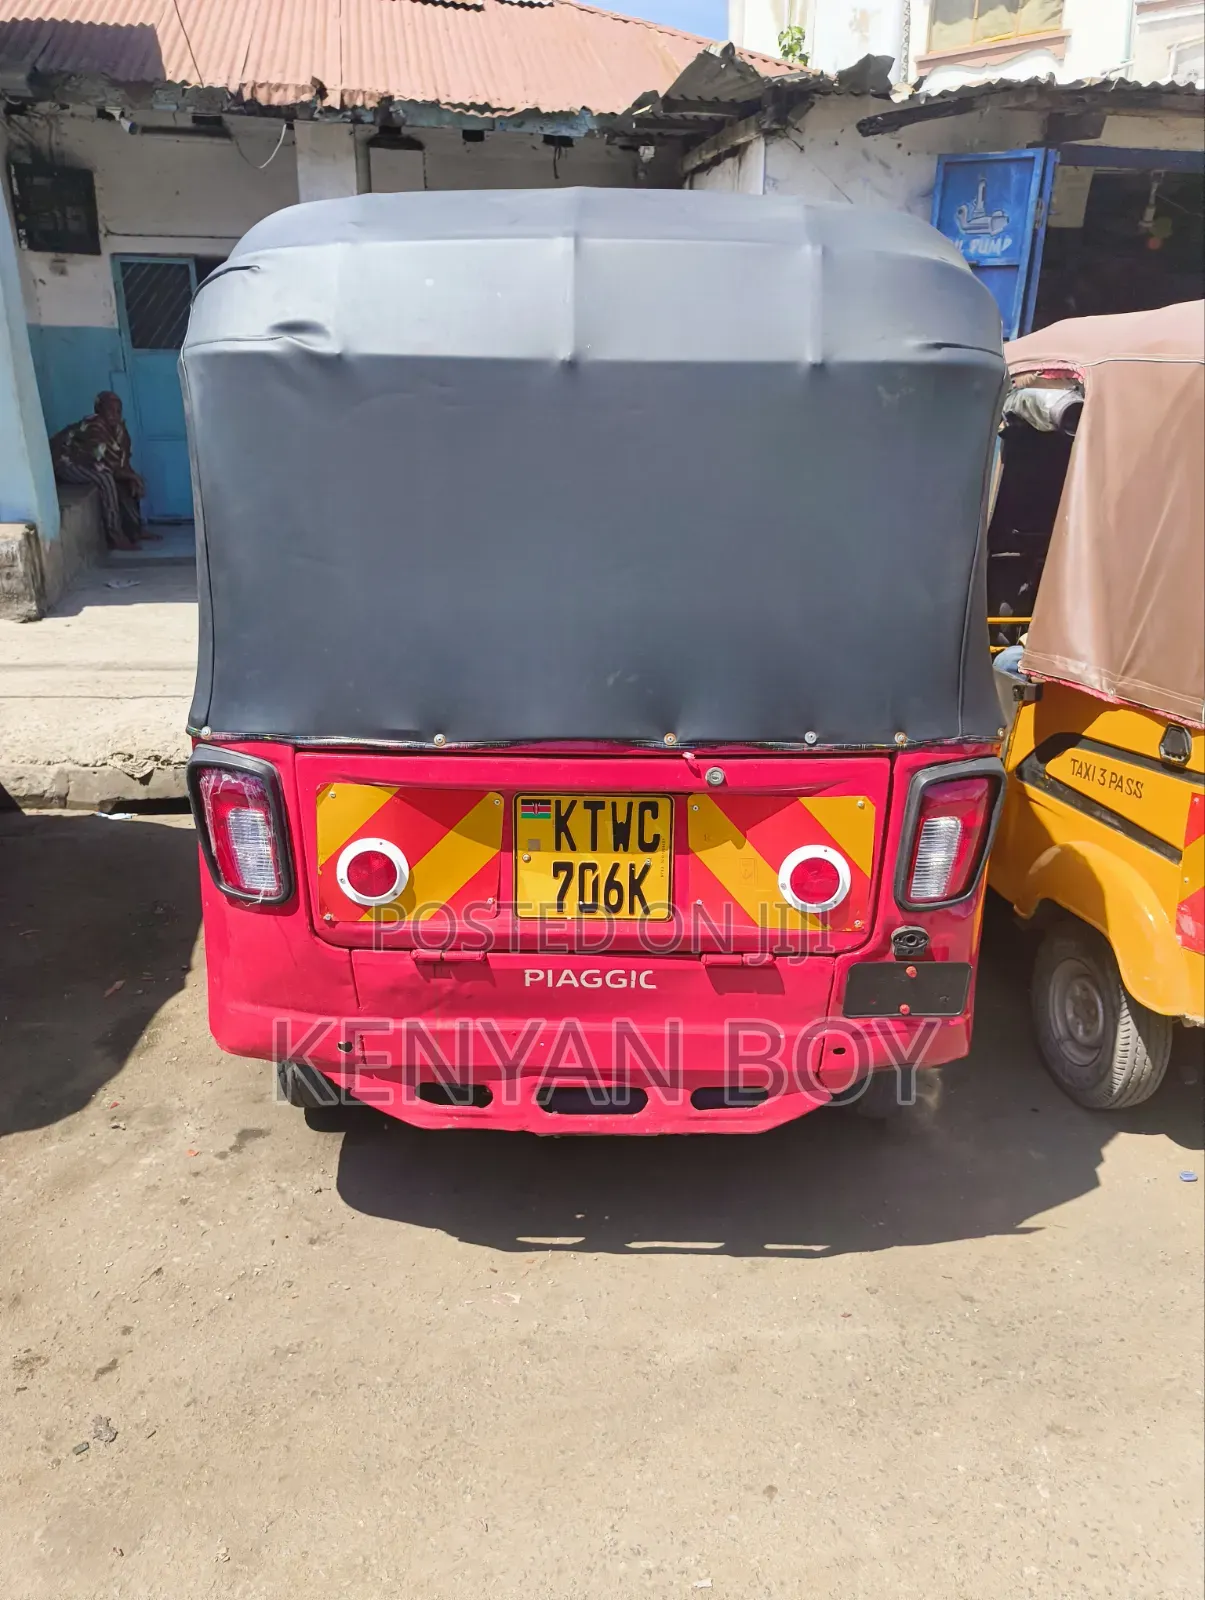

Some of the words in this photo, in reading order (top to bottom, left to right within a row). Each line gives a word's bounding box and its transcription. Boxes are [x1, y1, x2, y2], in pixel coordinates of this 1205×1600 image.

[969, 236, 1013, 256] PUMP
[1070, 758, 1097, 782] TAXI
[1097, 767, 1107, 786] 3
[1108, 771, 1144, 799] PASS
[554, 799, 661, 853] KTWC
[552, 861, 652, 915] 706K
